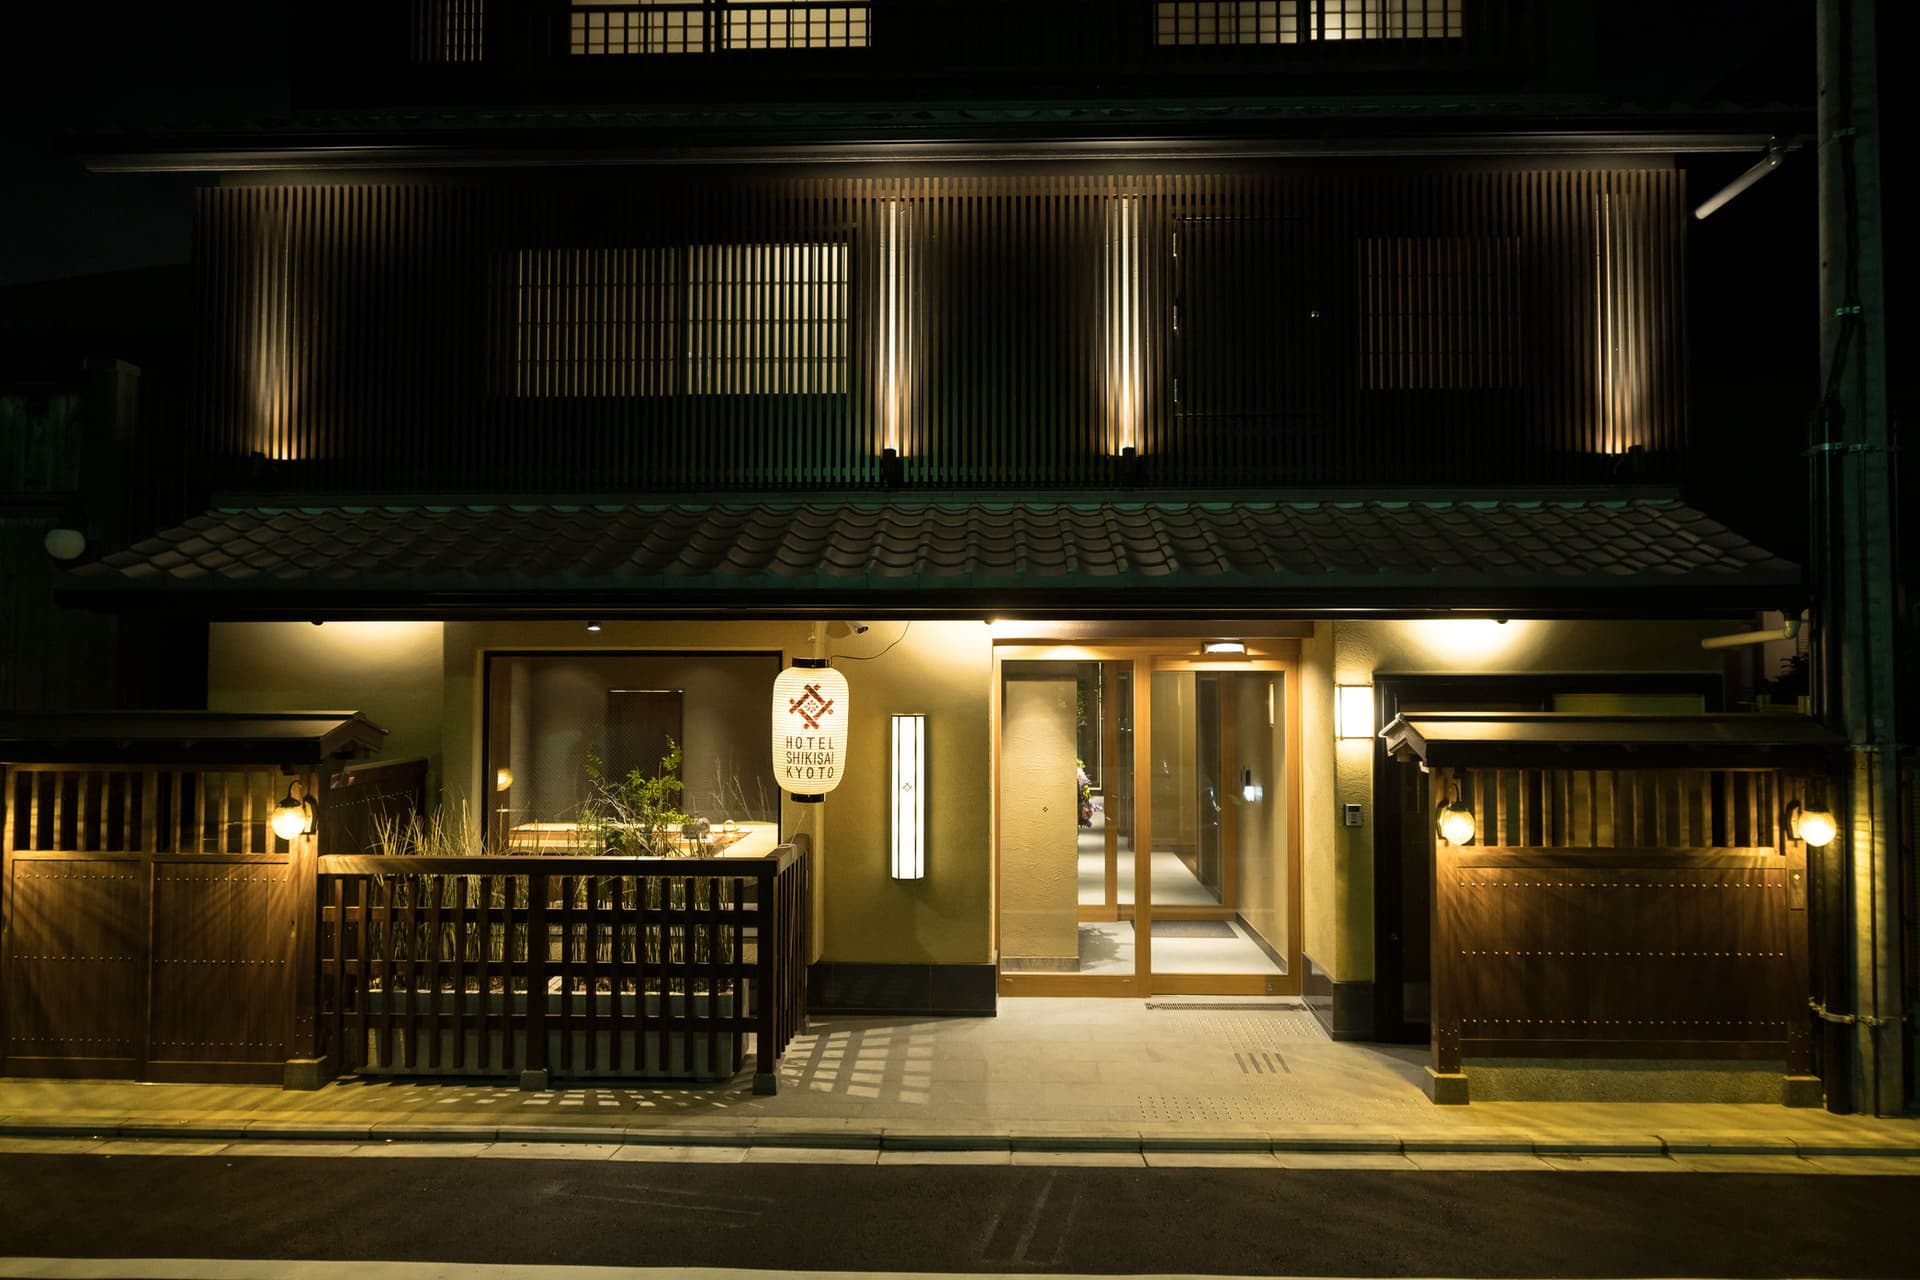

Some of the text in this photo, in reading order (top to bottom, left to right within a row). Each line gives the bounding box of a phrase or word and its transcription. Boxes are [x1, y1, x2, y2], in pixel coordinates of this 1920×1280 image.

[786, 736, 834, 750] HOTEL
[786, 751, 834, 765] SHIKISAI
[786, 766, 834, 779] KYOTO
